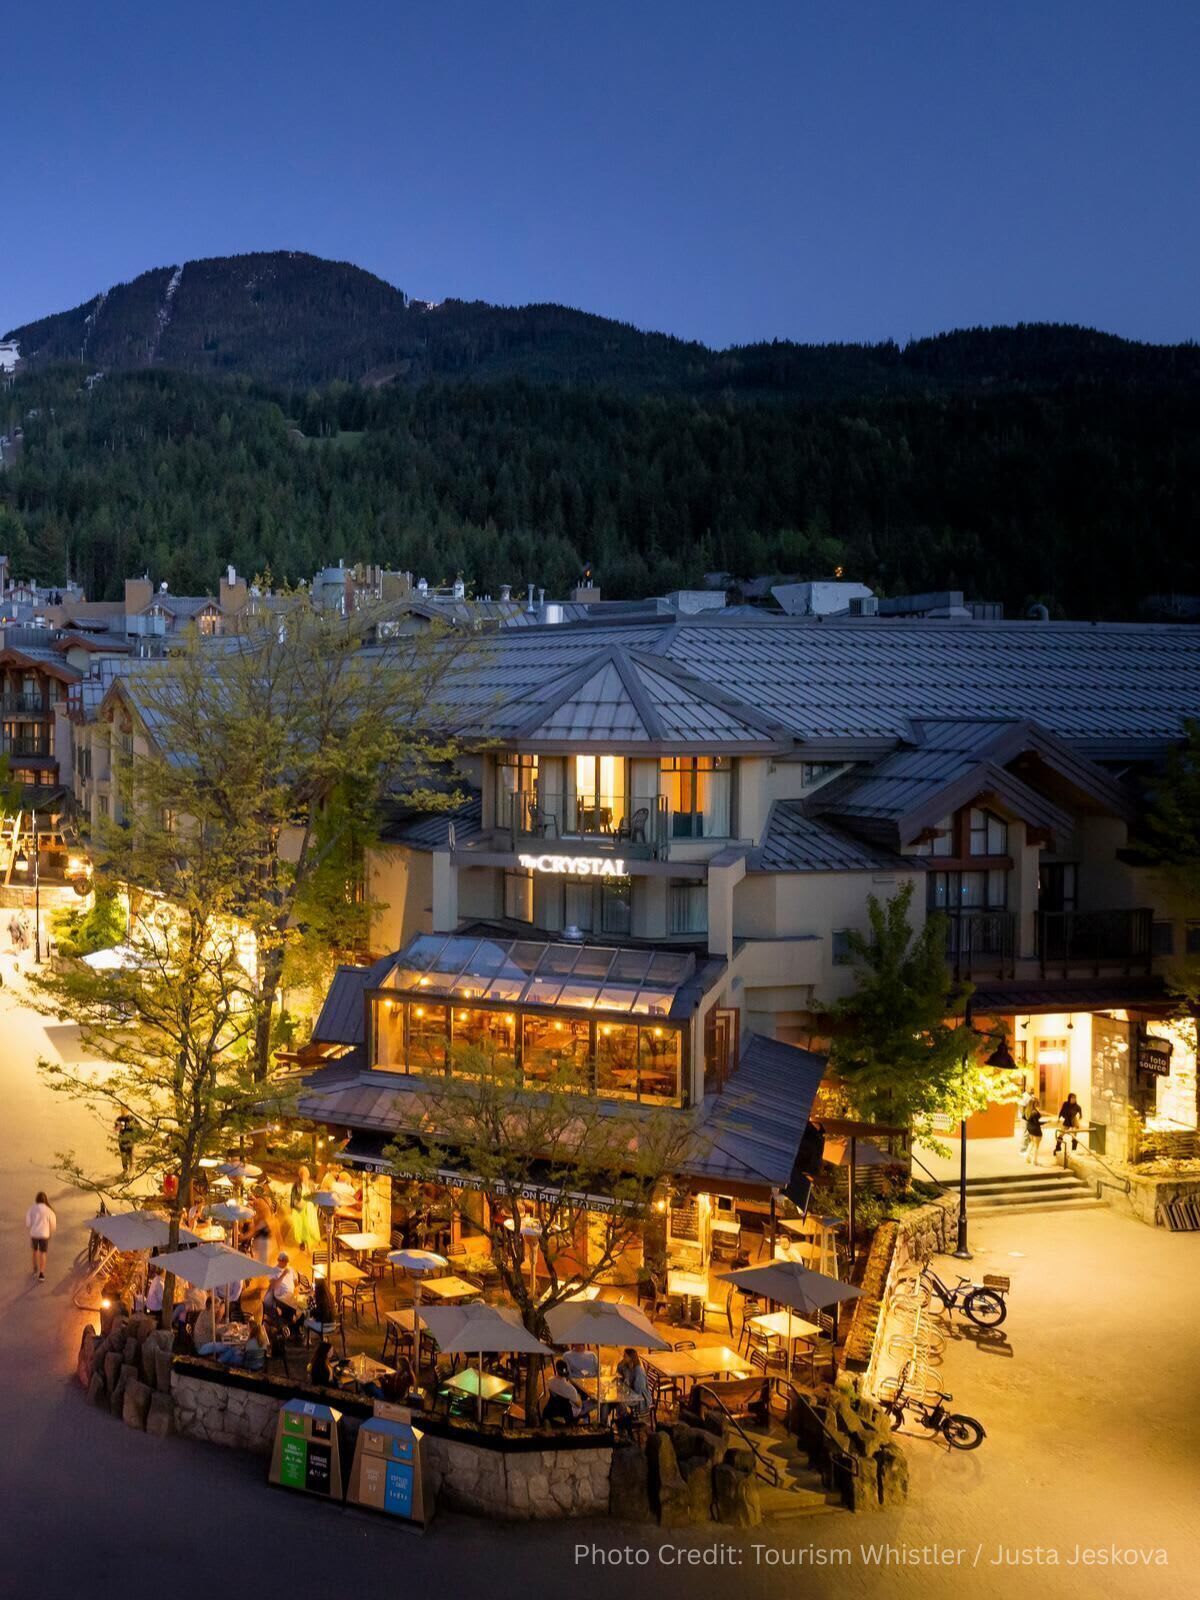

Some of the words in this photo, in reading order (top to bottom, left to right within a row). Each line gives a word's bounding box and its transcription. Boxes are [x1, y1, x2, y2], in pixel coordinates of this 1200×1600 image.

[536, 855, 629, 876] CRYSTAL
[1150, 1055, 1167, 1066] foto
[1139, 1061, 1167, 1072] source
